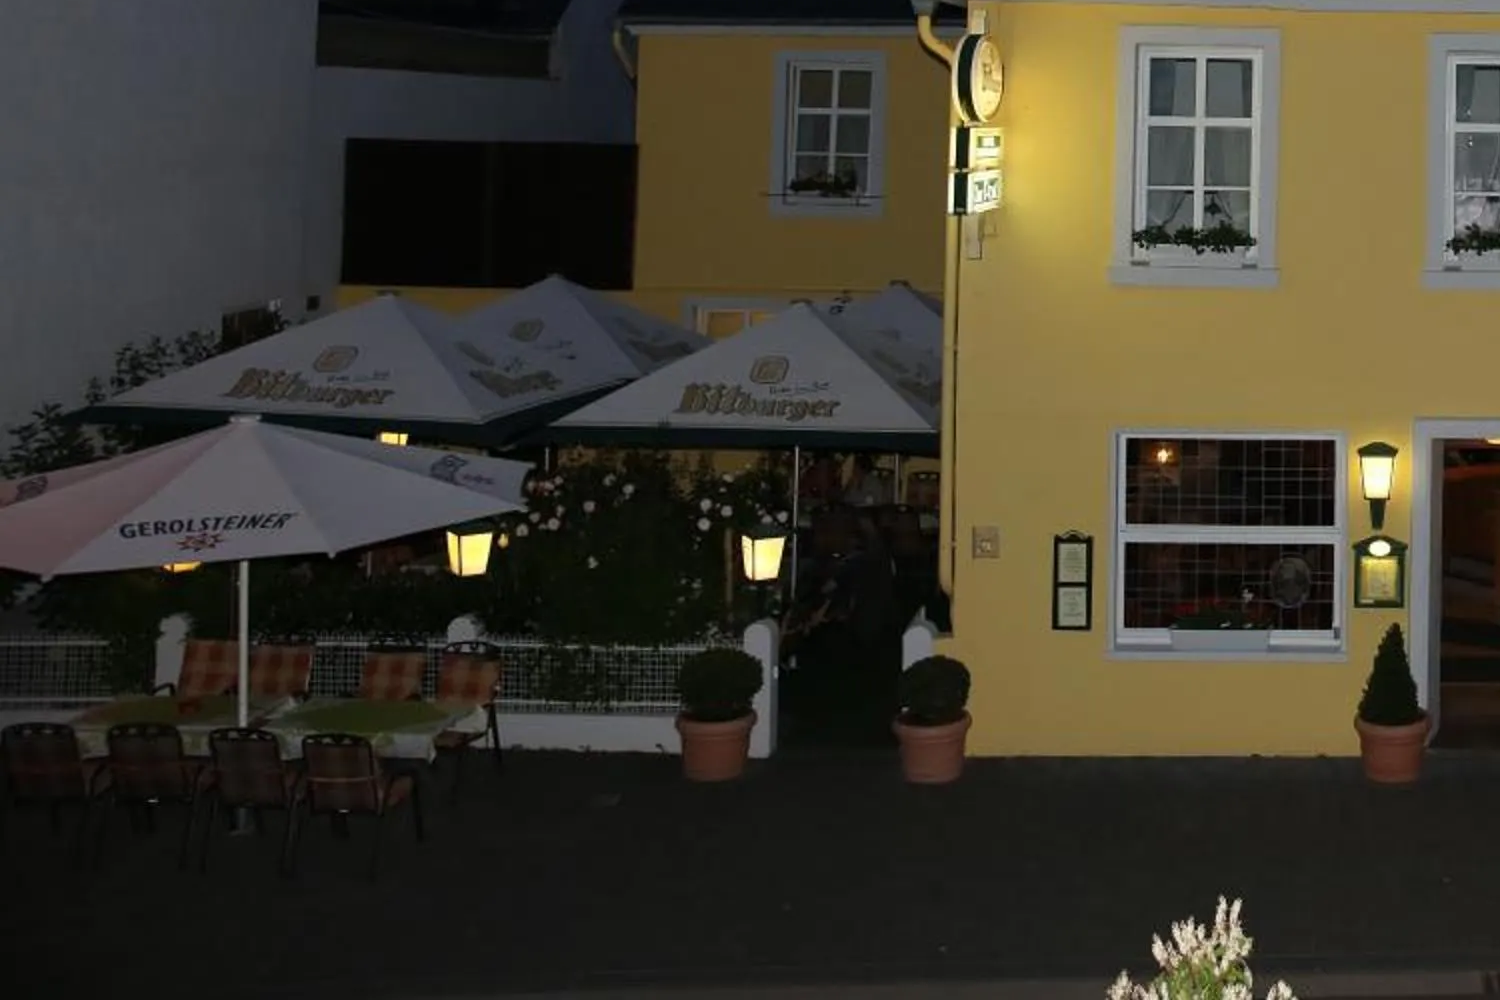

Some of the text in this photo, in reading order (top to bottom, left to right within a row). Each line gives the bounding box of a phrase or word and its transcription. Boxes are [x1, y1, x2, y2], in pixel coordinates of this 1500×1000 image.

[218, 367, 396, 408] Bitburger
[673, 383, 841, 422] Bitburger
[119, 512, 293, 539] GEROLSTEINER
